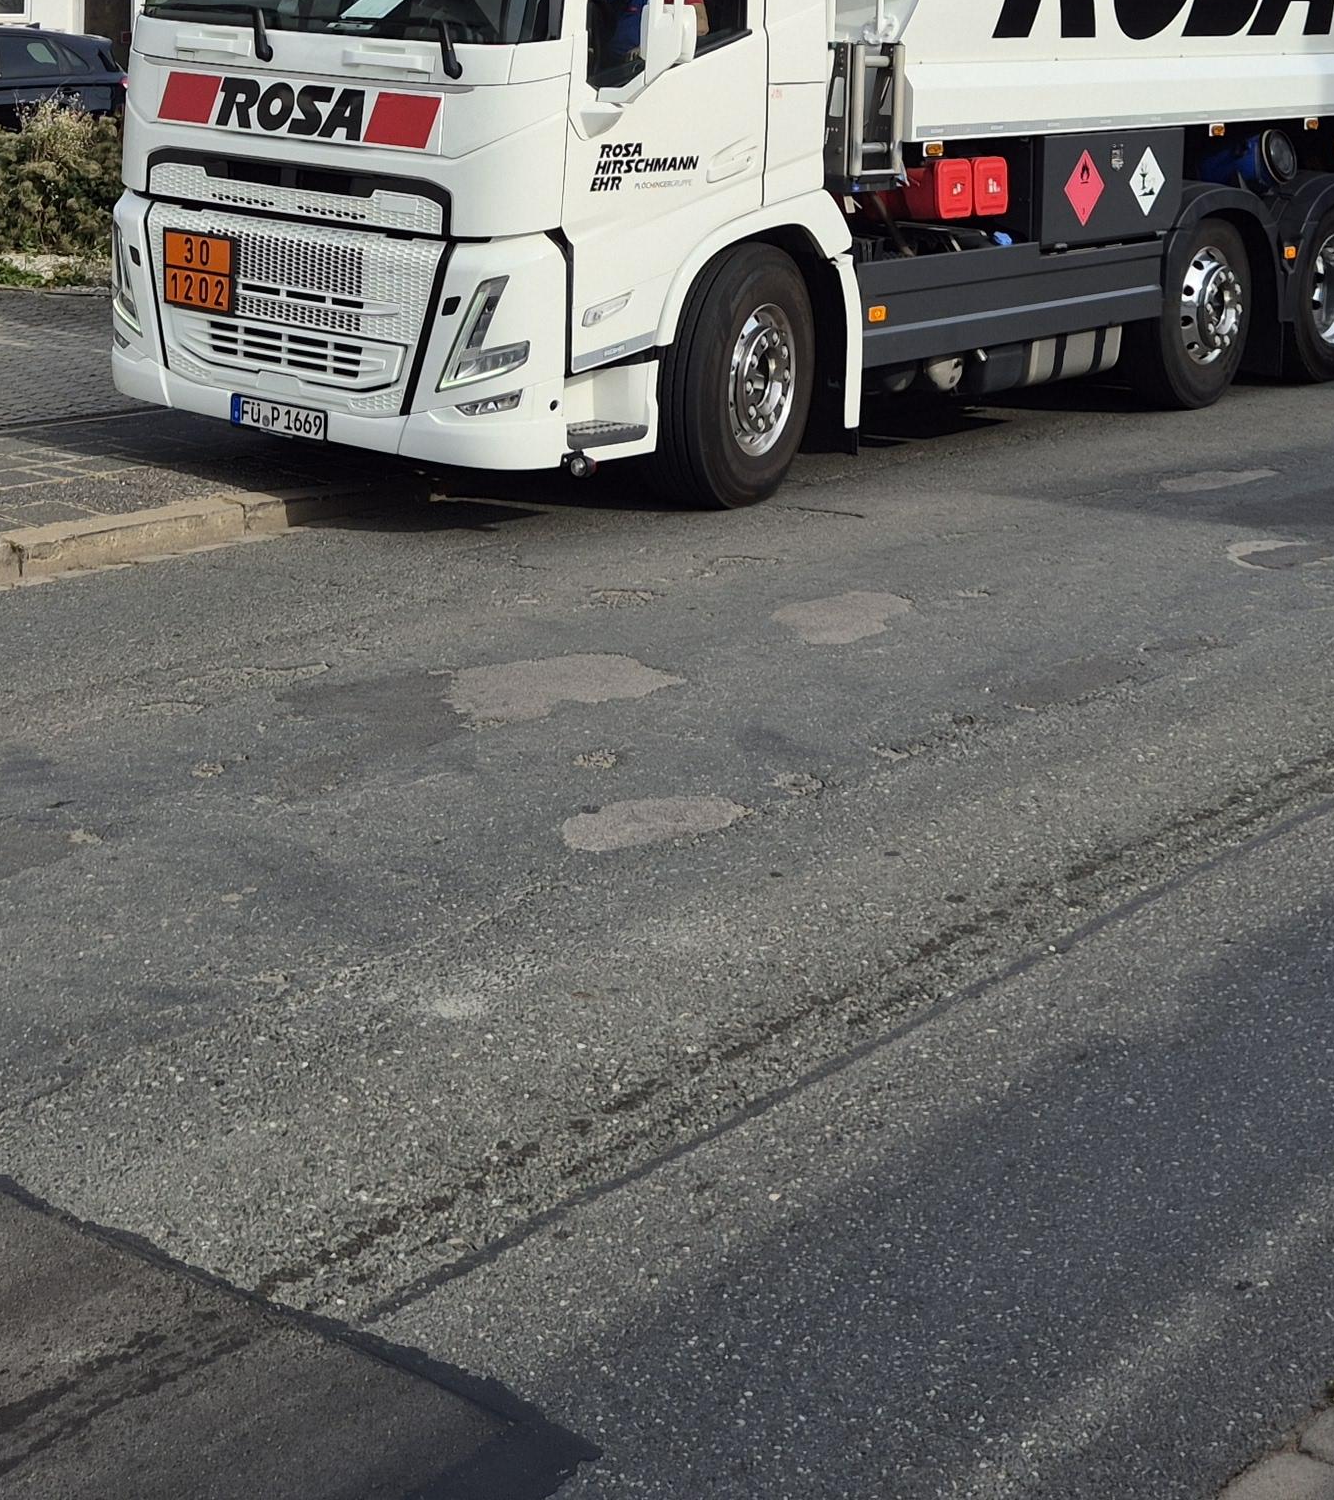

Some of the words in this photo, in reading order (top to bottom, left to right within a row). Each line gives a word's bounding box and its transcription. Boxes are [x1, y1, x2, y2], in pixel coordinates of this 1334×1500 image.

[214, 76, 366, 142] ROSA
[599, 142, 643, 159] ROSA
[594, 155, 700, 176] HIRSCHMANN
[589, 175, 623, 192] EHR
[184, 236, 210, 267] 30
[171, 272, 225, 307] 1202
